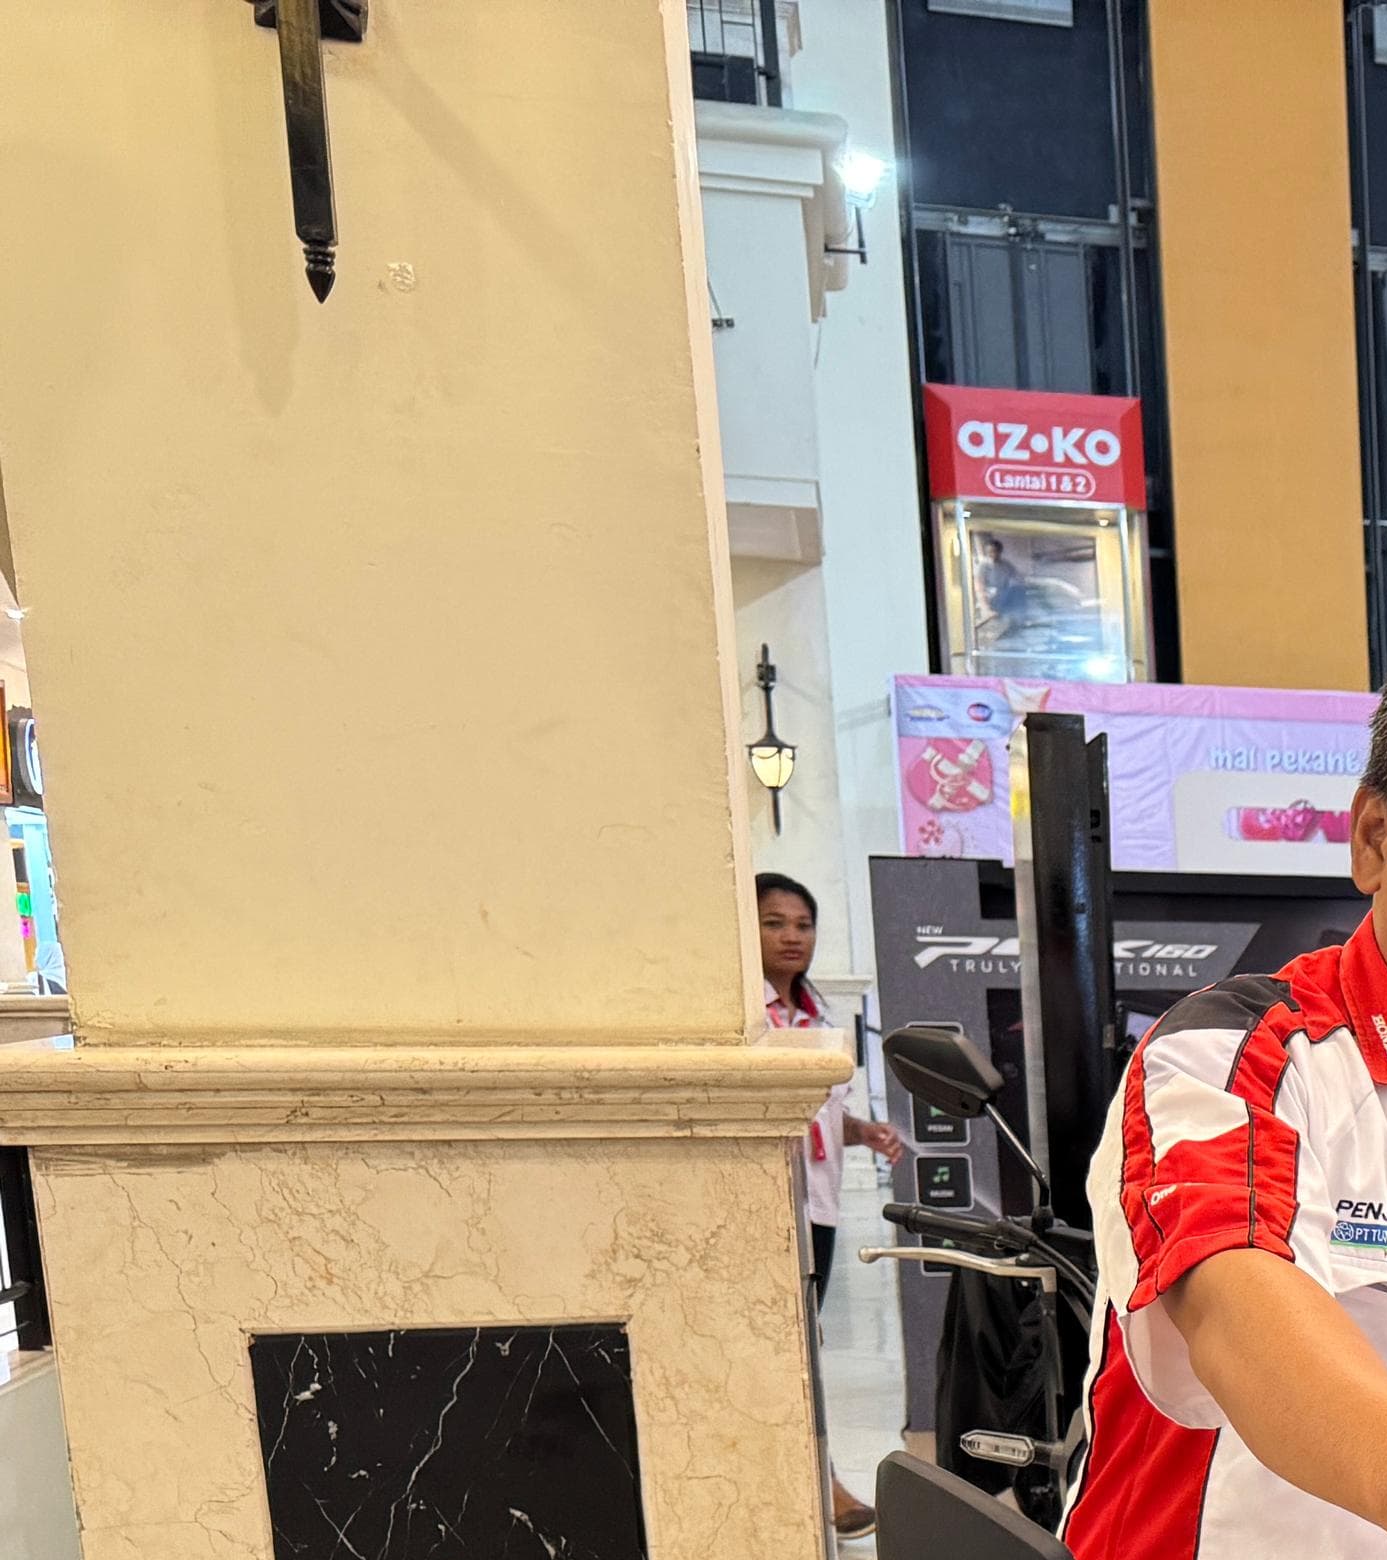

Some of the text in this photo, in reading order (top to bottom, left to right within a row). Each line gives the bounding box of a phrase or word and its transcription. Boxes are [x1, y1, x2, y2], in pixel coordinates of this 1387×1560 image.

[993, 472, 1046, 490] Lantai
[1050, 477, 1058, 491] 1
[1075, 479, 1087, 493] 2
[916, 925, 944, 935] NEW
[1355, 1227, 1372, 1241] PT
